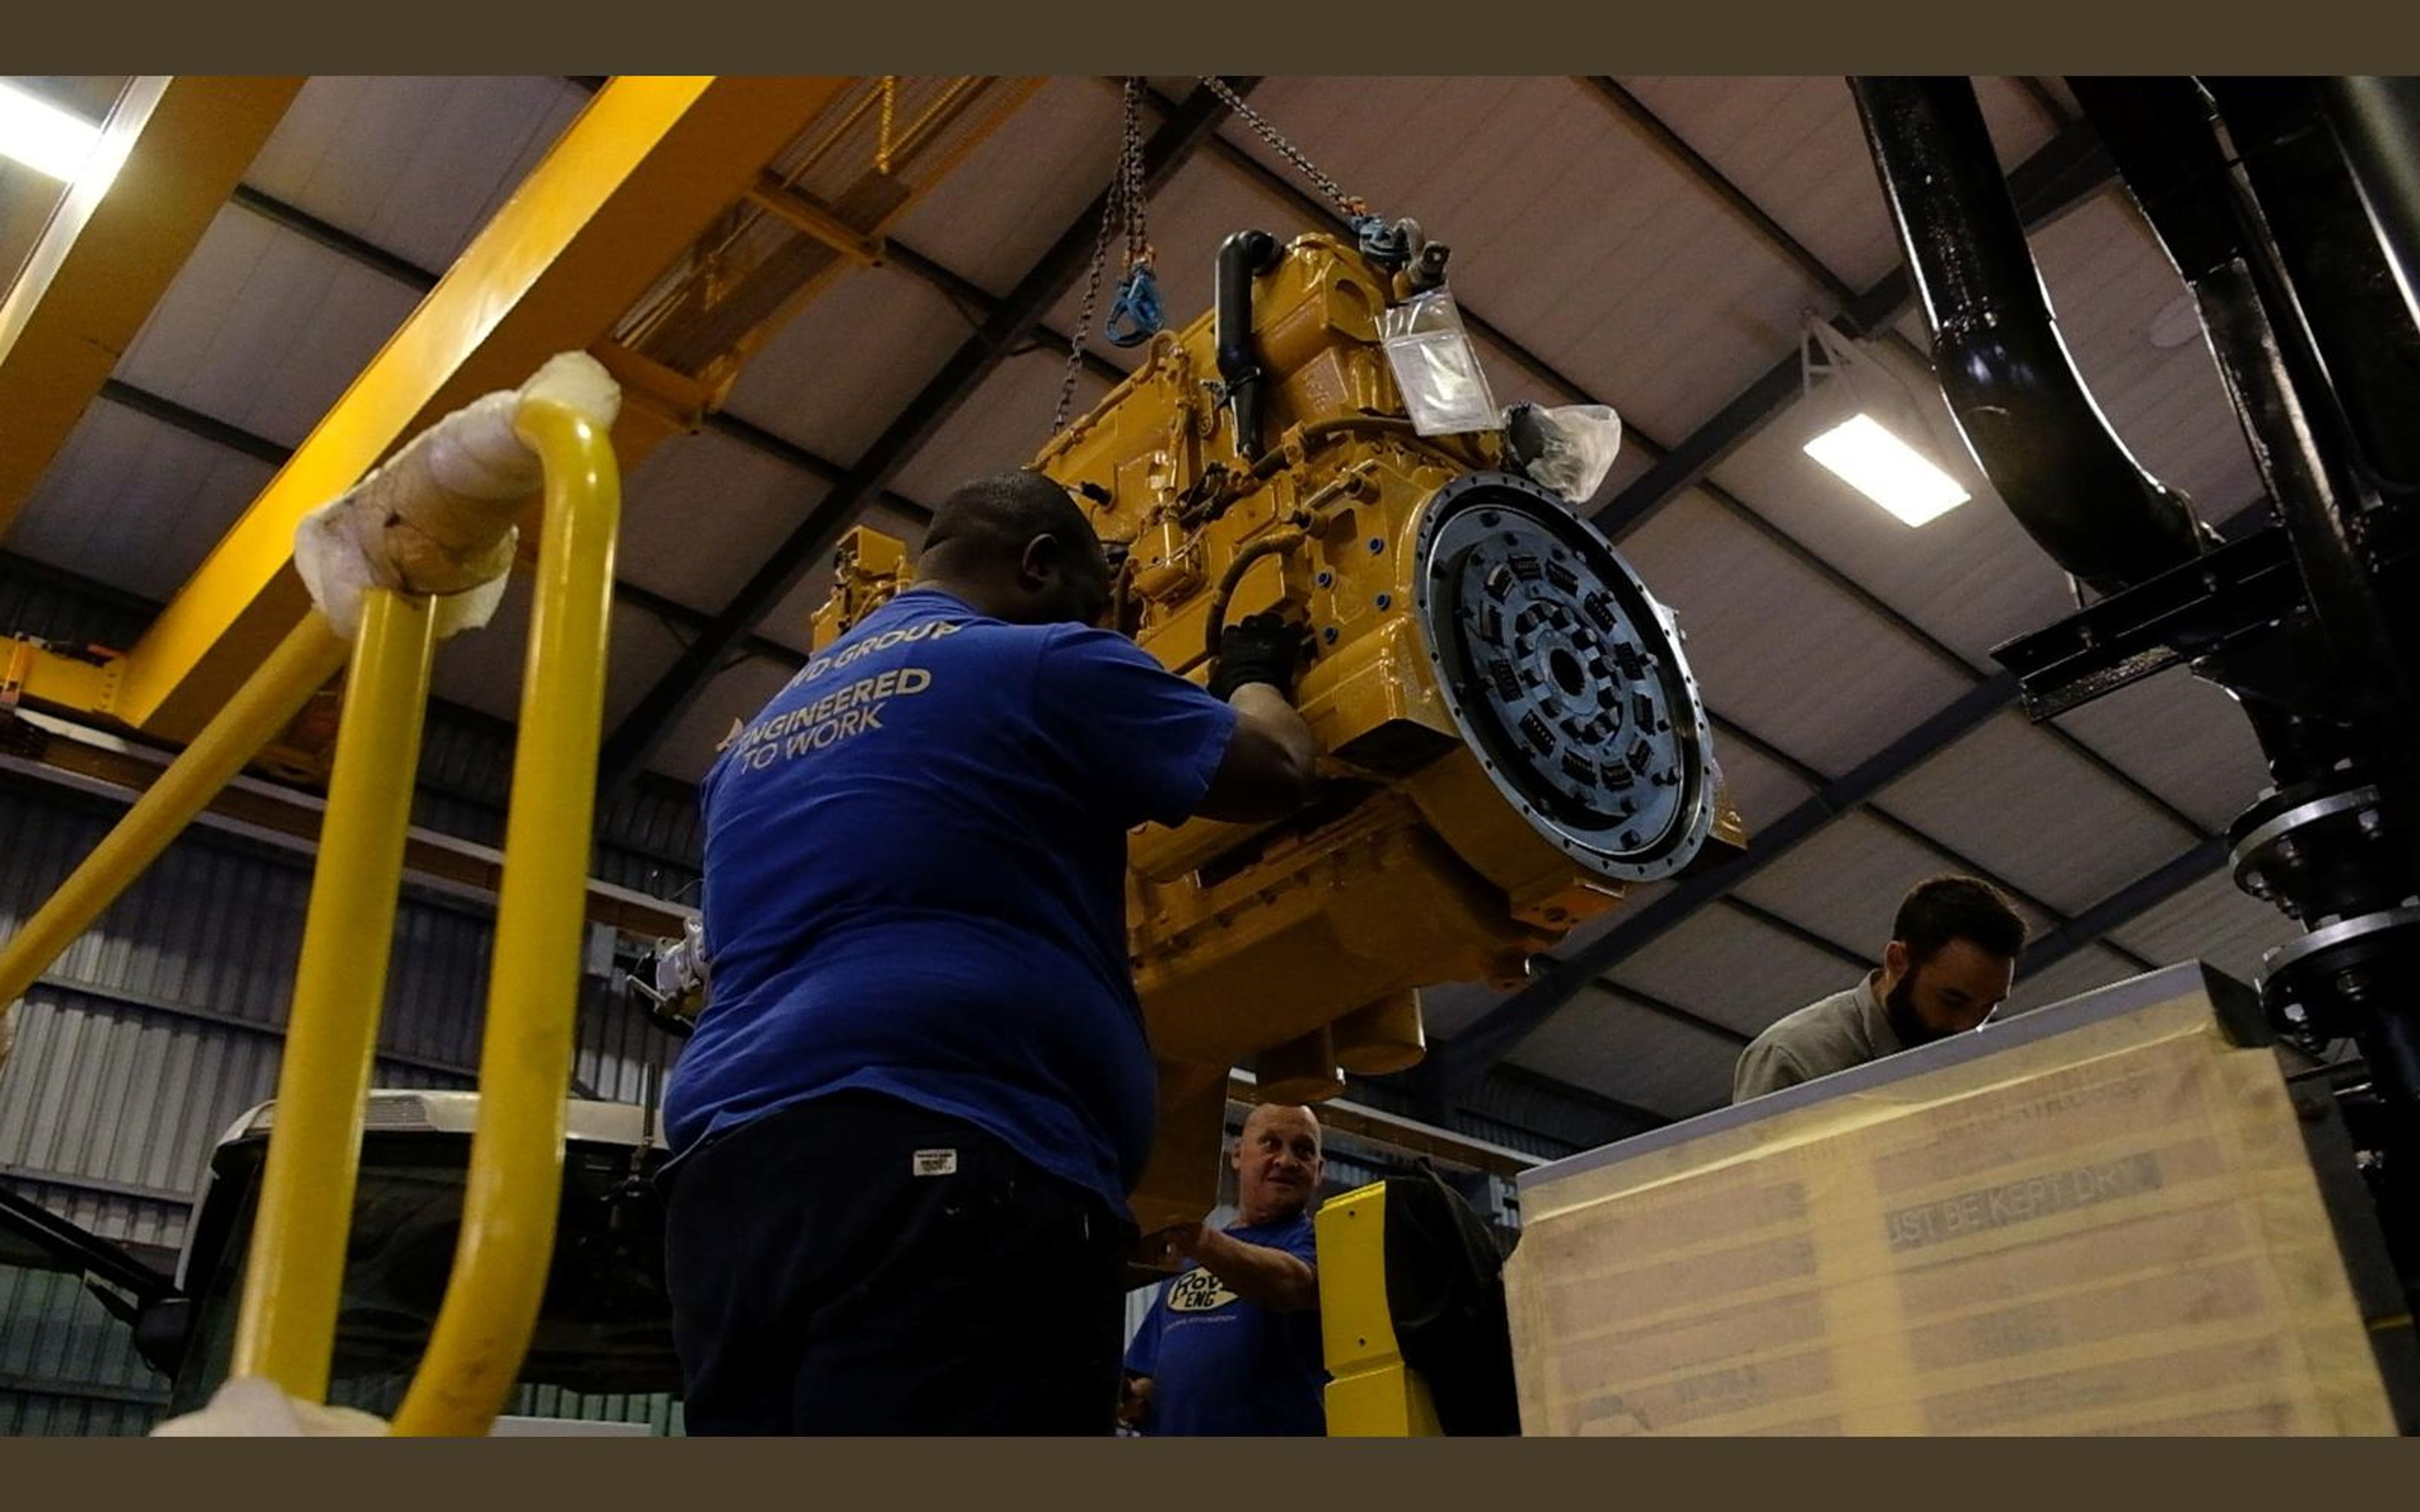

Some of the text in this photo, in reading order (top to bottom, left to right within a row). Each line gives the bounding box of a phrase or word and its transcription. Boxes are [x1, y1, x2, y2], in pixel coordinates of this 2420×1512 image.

[834, 620, 963, 668] GROUP
[739, 668, 931, 750] ENGINEERED
[740, 702, 886, 775] TO WORK
[1943, 1195, 1980, 1231] BE
[1988, 1172, 2062, 1225] KEPT
[1185, 1291, 1216, 1307] ENG
